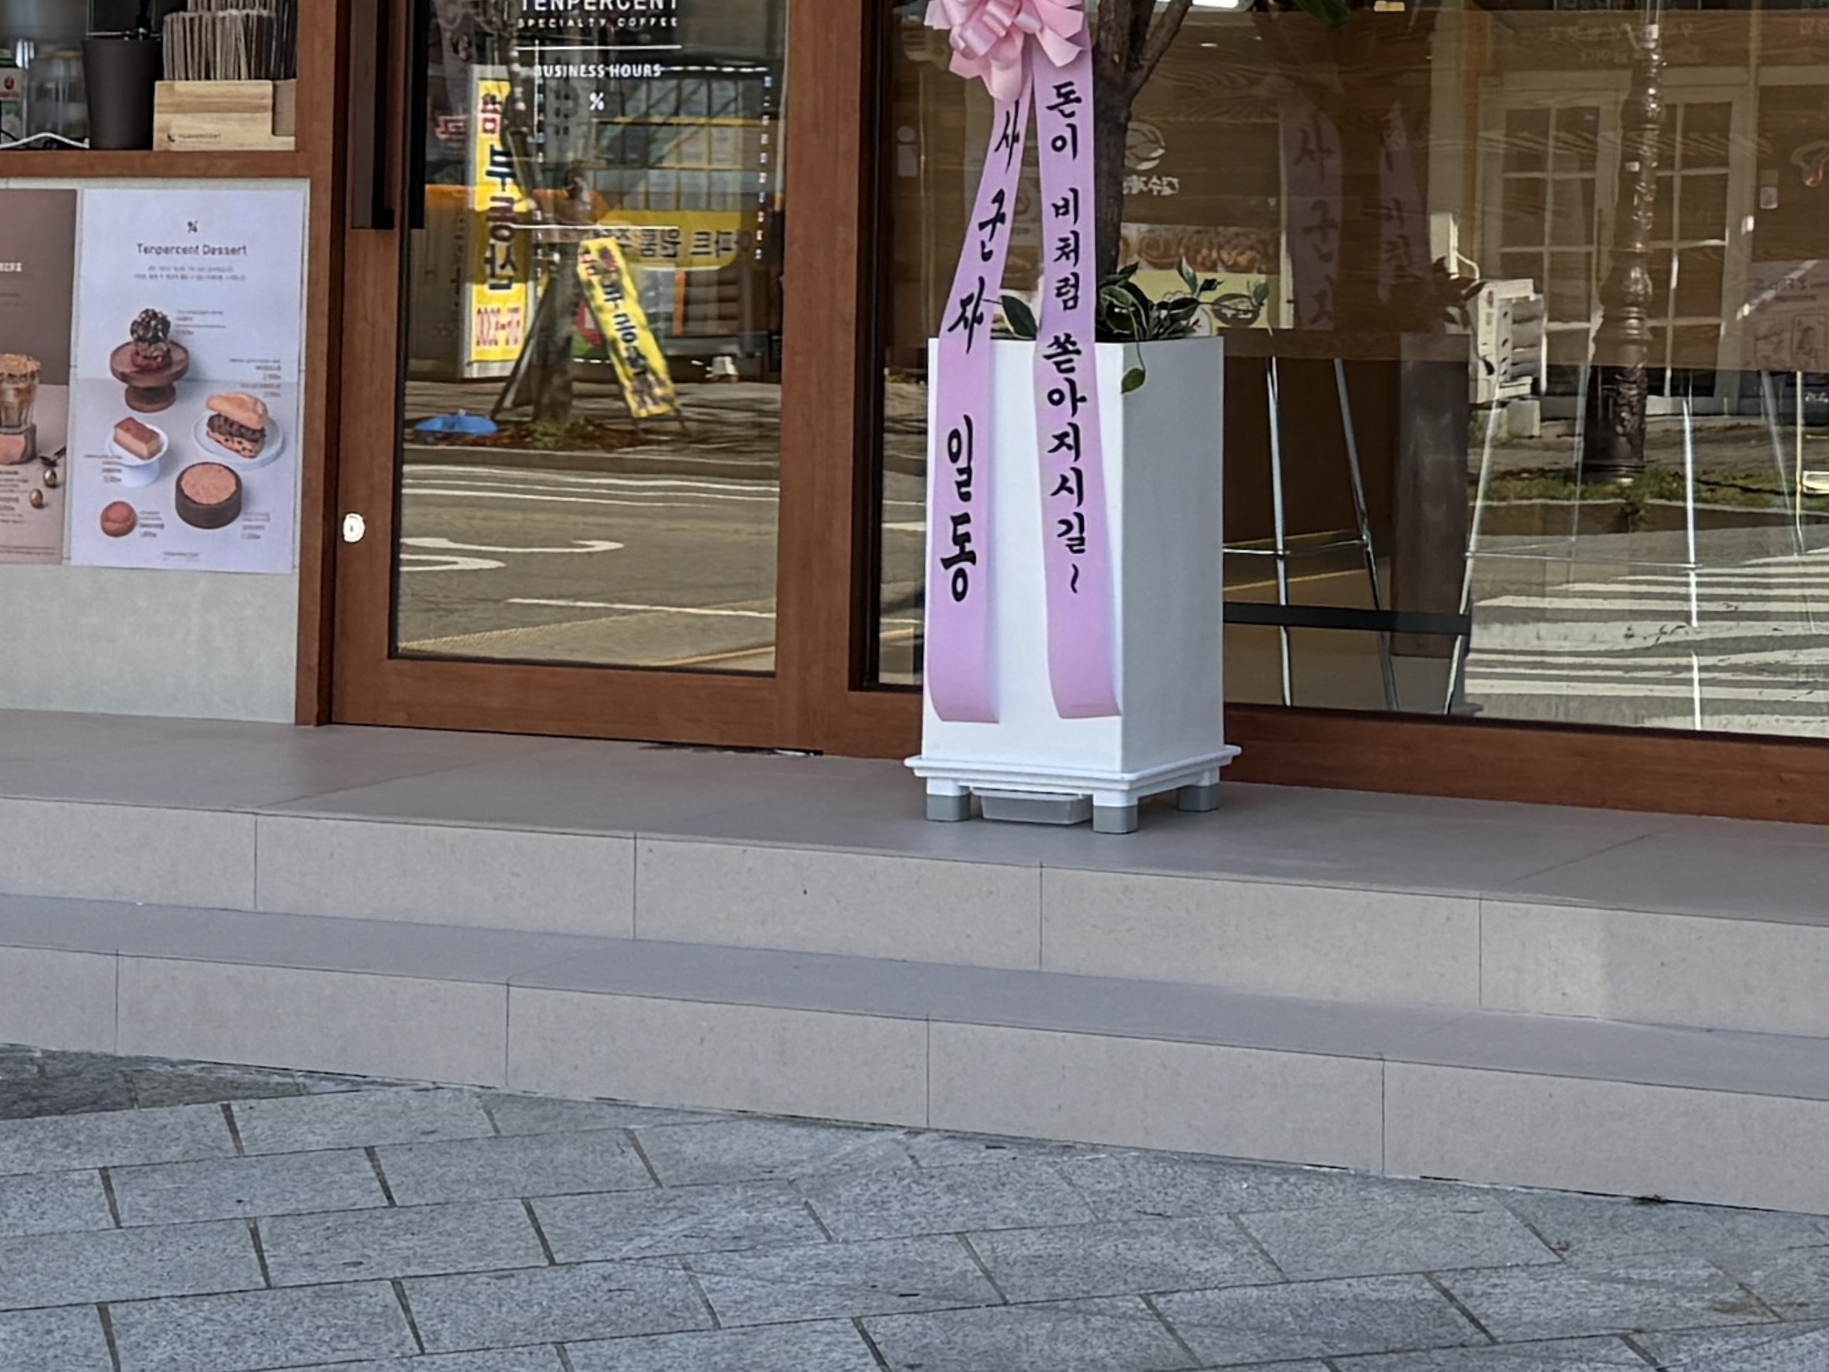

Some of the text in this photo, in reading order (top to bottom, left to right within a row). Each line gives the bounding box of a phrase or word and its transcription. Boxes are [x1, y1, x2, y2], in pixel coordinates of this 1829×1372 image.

[519, 16, 678, 29] SPECIALTY COFFEE
[534, 62, 662, 79] BUSINESS HOURS
[1046, 80, 1083, 161] 돈이
[136, 242, 200, 257] Tenpercent
[1051, 186, 1080, 313] 비처럼
[939, 414, 977, 603] 일동
